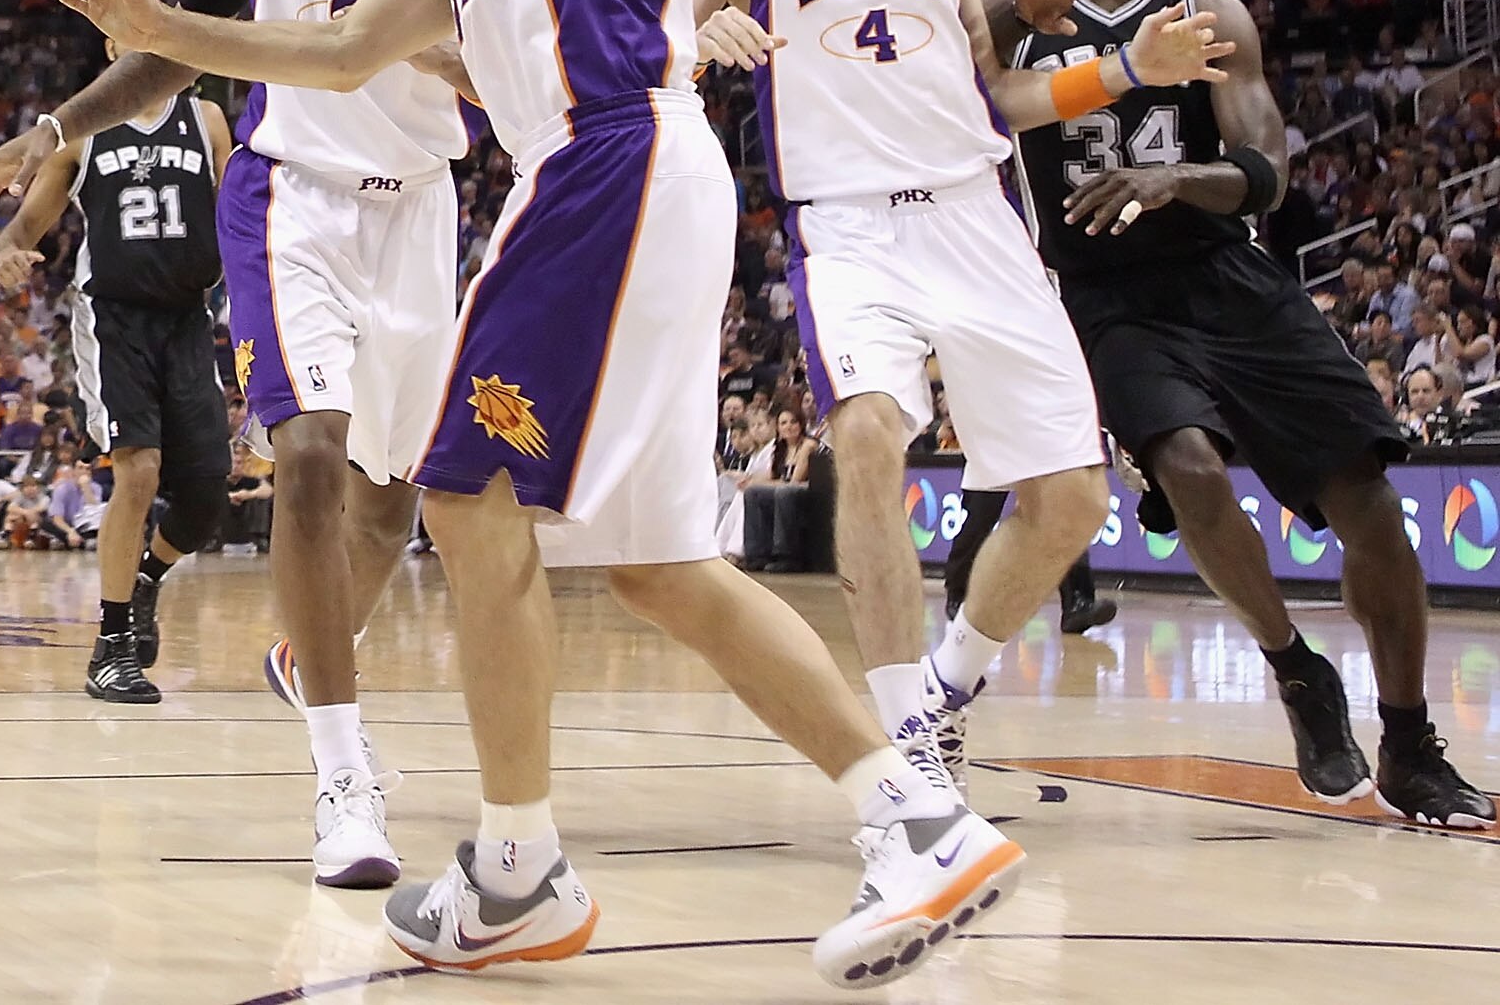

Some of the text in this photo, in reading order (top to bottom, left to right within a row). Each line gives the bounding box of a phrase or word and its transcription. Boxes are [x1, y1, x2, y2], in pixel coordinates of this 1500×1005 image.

[854, 7, 900, 64] 4
[95, 144, 203, 178] SPURS
[1060, 105, 1186, 191] 34
[358, 176, 403, 193] PHX
[889, 189, 936, 208] PHX
[119, 183, 188, 240] 21
